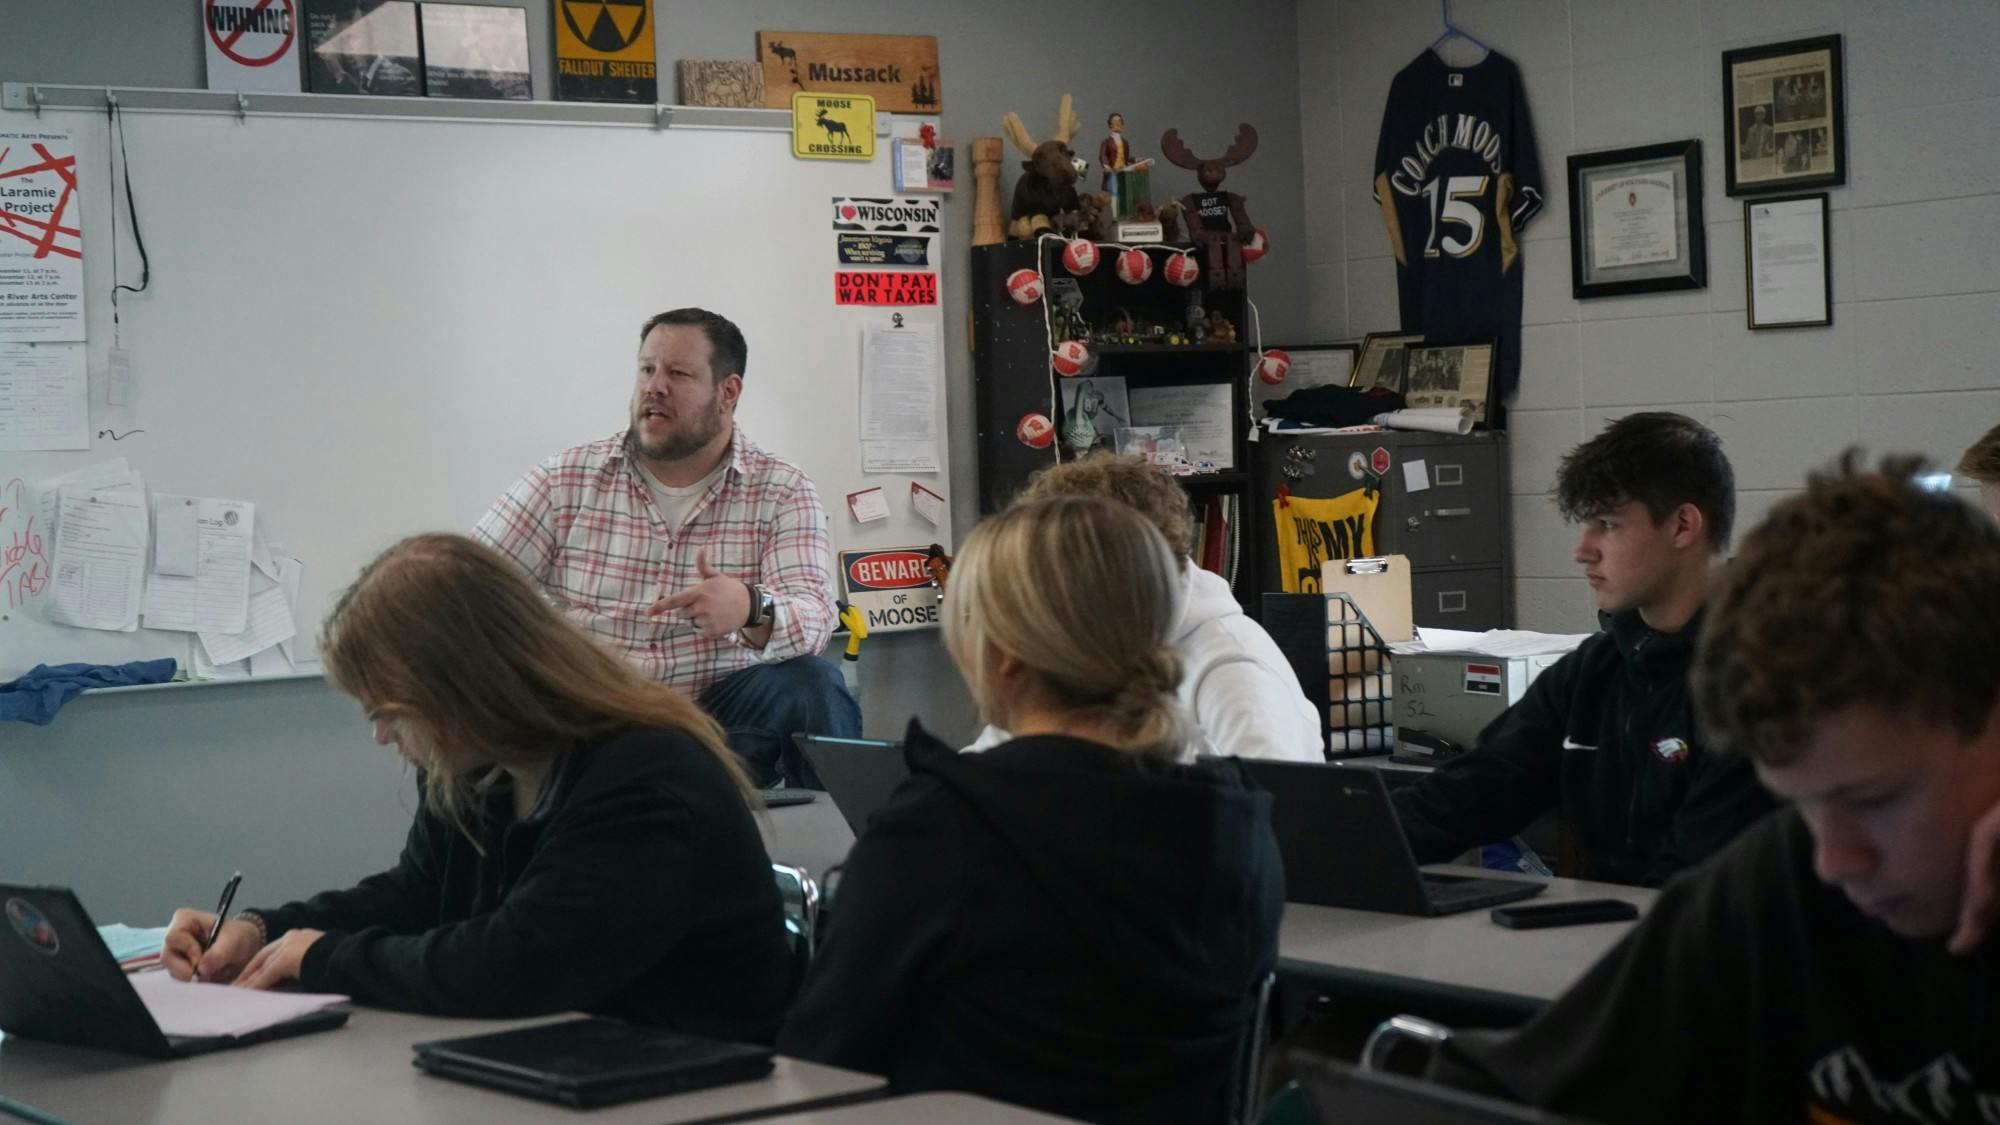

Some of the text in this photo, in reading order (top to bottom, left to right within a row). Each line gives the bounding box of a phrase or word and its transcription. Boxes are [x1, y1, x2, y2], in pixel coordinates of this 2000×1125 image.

[210, 5, 292, 35] WHINING
[559, 59, 656, 78] FALLOUT SHELTER
[808, 63, 901, 83] Mussack
[816, 99, 852, 108] MOOSE
[808, 144, 862, 154] CROSSING
[1391, 114, 1449, 196] COACH
[0, 187, 56, 198] Laramie
[4, 202, 56, 215] Project
[1201, 198, 1217, 207] GOT
[834, 206, 937, 222] I WISCONSIN
[1421, 175, 1490, 259] 15
[840, 274, 933, 288] DON'T PAY
[839, 289, 936, 303] WAR TAXES
[1293, 516, 1322, 546] THIS
[1317, 513, 1366, 561] MY
[893, 594, 908, 605] OF
[868, 605, 940, 627] MOOSE
